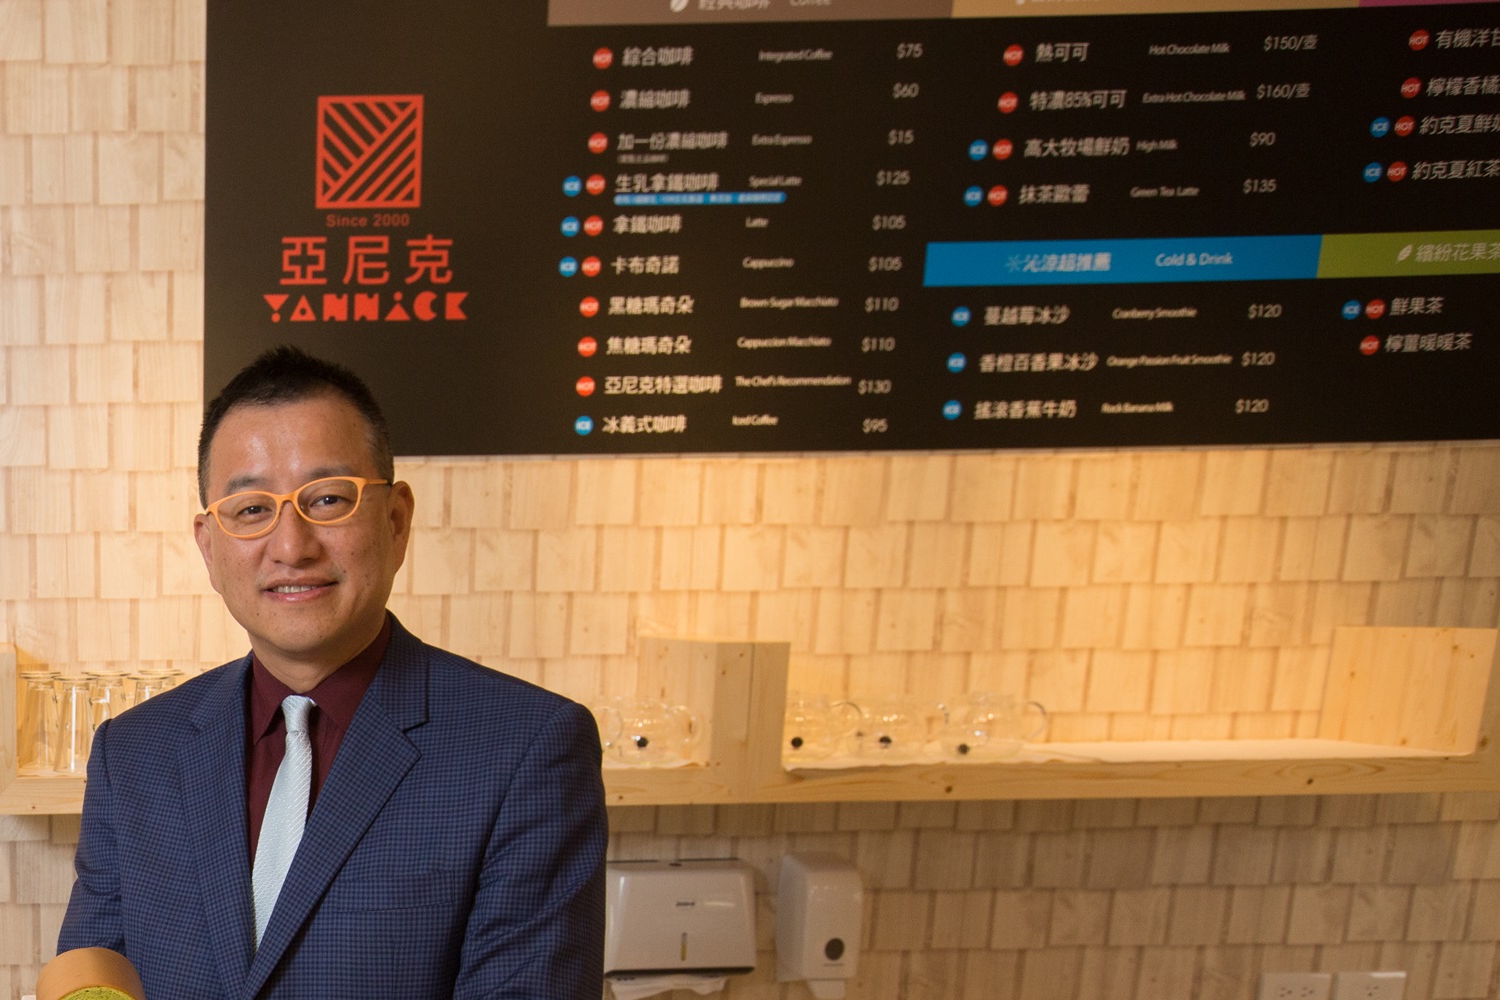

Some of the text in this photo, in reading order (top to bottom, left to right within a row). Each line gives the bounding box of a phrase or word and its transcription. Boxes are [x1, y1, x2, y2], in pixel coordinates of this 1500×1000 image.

[1410, 34, 1430, 45] HOT
[621, 46, 694, 67] 綜合咖啡
[896, 42, 923, 59] $75
[1004, 50, 1024, 61] HOT
[1035, 42, 1090, 63] 熱可可
[1149, 44, 1166, 55] Hot
[1166, 43, 1210, 55] Chocolate
[892, 82, 920, 99] $60
[1402, 82, 1422, 94] HOT
[1425, 75, 1500, 98] 檸檬香橘
[998, 98, 1018, 108] HOT
[1371, 120, 1415, 132] ICE HOT
[888, 128, 915, 146] $15
[1250, 131, 1276, 148] $90
[970, 144, 1012, 156] ICE HOT
[876, 169, 911, 187] $125
[1364, 166, 1408, 178] ICE HOT
[563, 179, 606, 192] ICE HOT
[1242, 178, 1277, 195] $135
[964, 190, 1008, 202] ICE HOT
[325, 213, 411, 228] Since 2000
[561, 220, 604, 232] ICE HOT
[872, 214, 906, 231] $105
[279, 233, 454, 286] 亞尼克
[610, 255, 680, 275] 卡布奇諾
[868, 256, 902, 272] $105
[1155, 251, 1234, 267] Cold & Drink
[559, 262, 602, 272] ICE HOT
[579, 301, 599, 312] HOT
[865, 296, 899, 313] $110
[1248, 303, 1282, 320] $120
[1342, 304, 1386, 316] ICE HOT
[1389, 296, 1445, 316] 鮮果茶
[952, 310, 970, 322] ICE
[577, 342, 597, 352] HOT
[861, 336, 896, 353] $110
[1360, 340, 1380, 350] HOT
[948, 357, 966, 368] ICE
[1241, 350, 1276, 367] $120
[576, 381, 596, 392] HOT
[858, 379, 892, 396] $130
[943, 404, 961, 416] ICE
[1235, 398, 1270, 415] $120
[574, 420, 592, 431] ICE
[862, 418, 888, 434] $95
